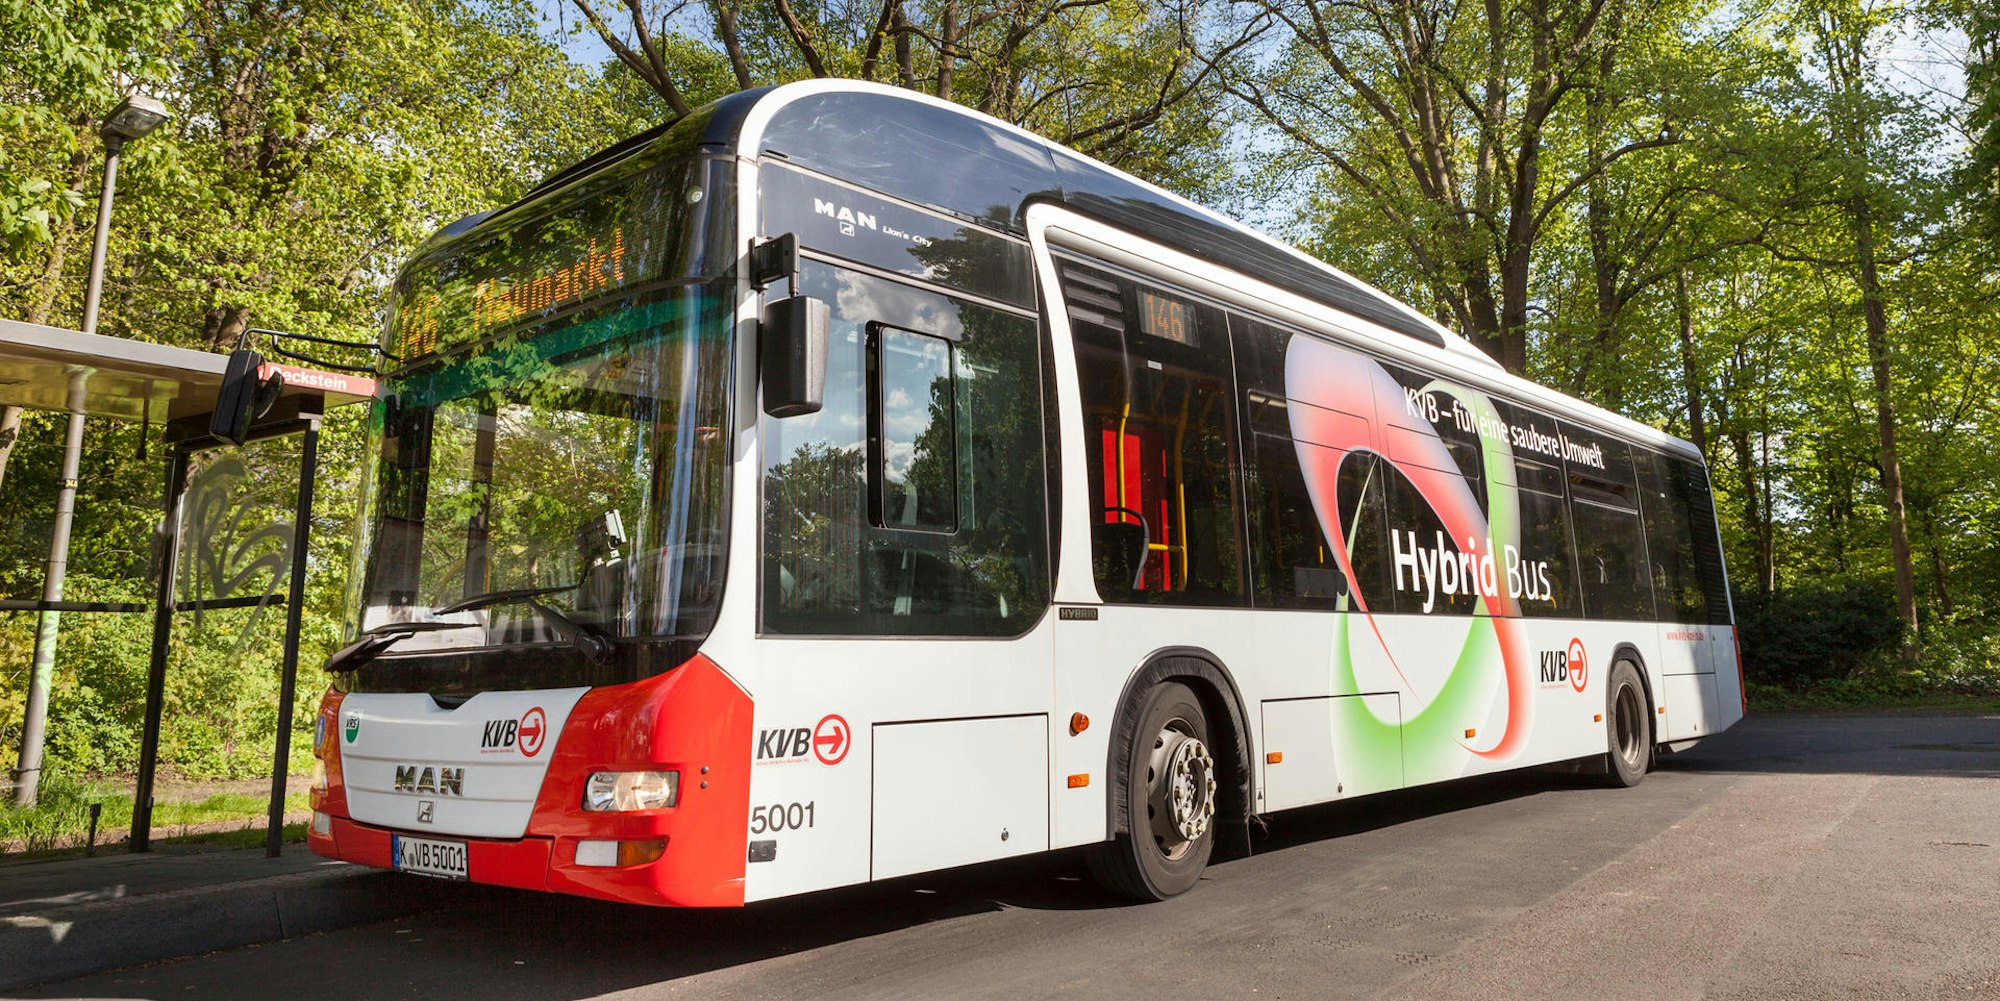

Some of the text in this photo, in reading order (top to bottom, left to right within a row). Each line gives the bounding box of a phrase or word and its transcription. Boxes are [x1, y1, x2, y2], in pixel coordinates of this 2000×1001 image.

[814, 198, 933, 248] MAN Lion's City
[401, 228, 624, 363] 146 Neumarkt
[1147, 294, 1182, 342] 146
[1403, 386, 1438, 423] KVB
[1452, 399, 1476, 434] für
[1480, 412, 1509, 443] eine
[1511, 424, 1559, 457] saubere
[1558, 433, 1605, 470] Umwelt
[1391, 529, 1551, 614] Hybrid Bus
[1060, 608, 1097, 619] HYBRID
[1541, 650, 1567, 682] KVB
[346, 718, 358, 728] VRS
[481, 719, 518, 747] KVB
[757, 728, 811, 759] KVB
[395, 766, 465, 796] MAN
[751, 801, 814, 834] 5001
